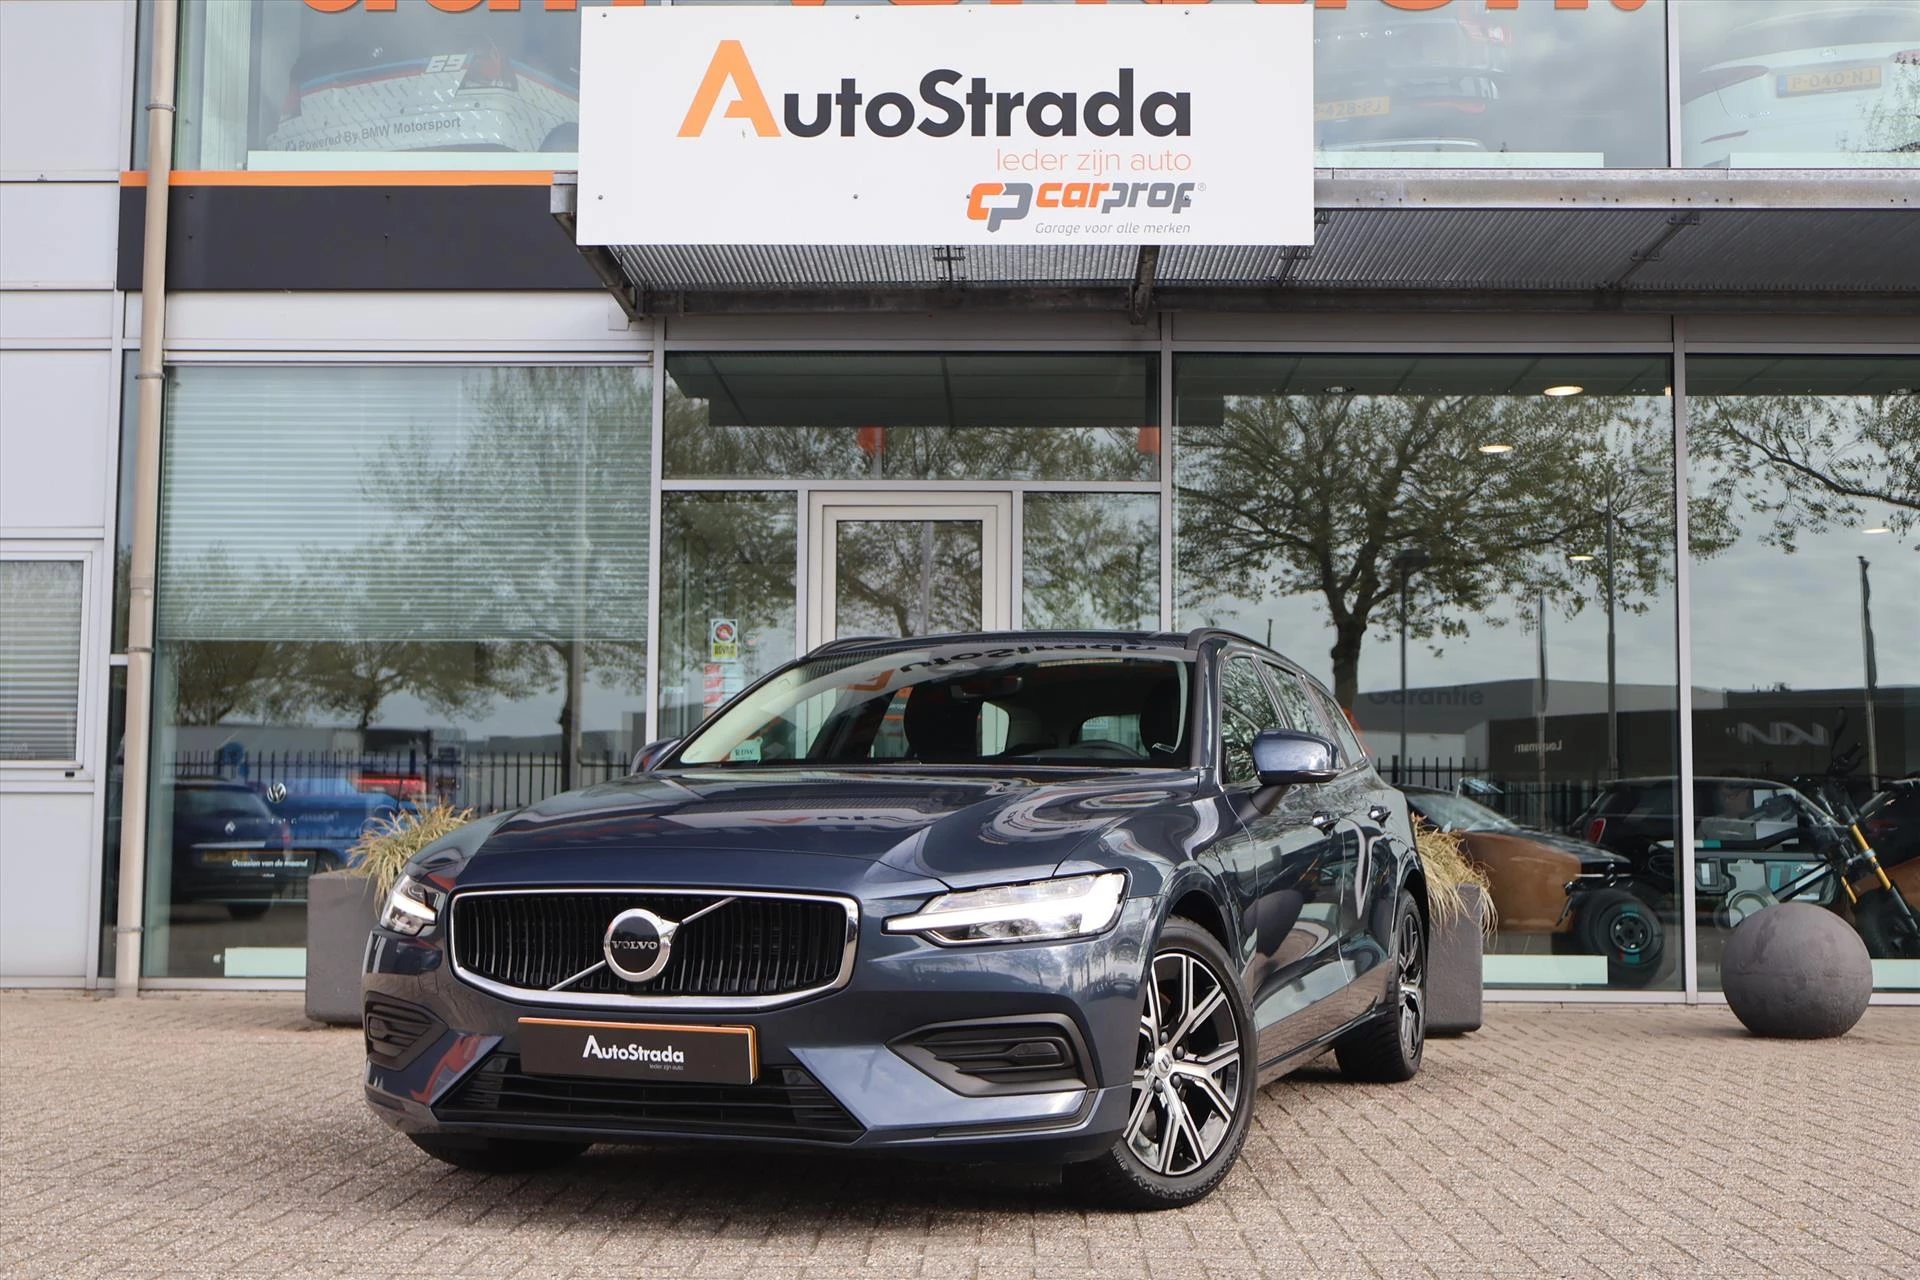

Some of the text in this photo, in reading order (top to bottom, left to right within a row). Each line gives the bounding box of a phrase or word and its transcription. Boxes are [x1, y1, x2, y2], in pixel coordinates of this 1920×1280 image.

[425, 54, 467, 73] 69
[676, 40, 1192, 137] AutoStrada
[298, 116, 462, 152] Powered By BMW Motorsport
[1076, 149, 1121, 176] zijn
[1130, 152, 1192, 171] auto
[1035, 222, 1191, 236] Garage voor alle merken
[1367, 684, 1485, 706] Garantie
[611, 940, 658, 950] VOLVO
[582, 1034, 684, 1063] AutoStrada
